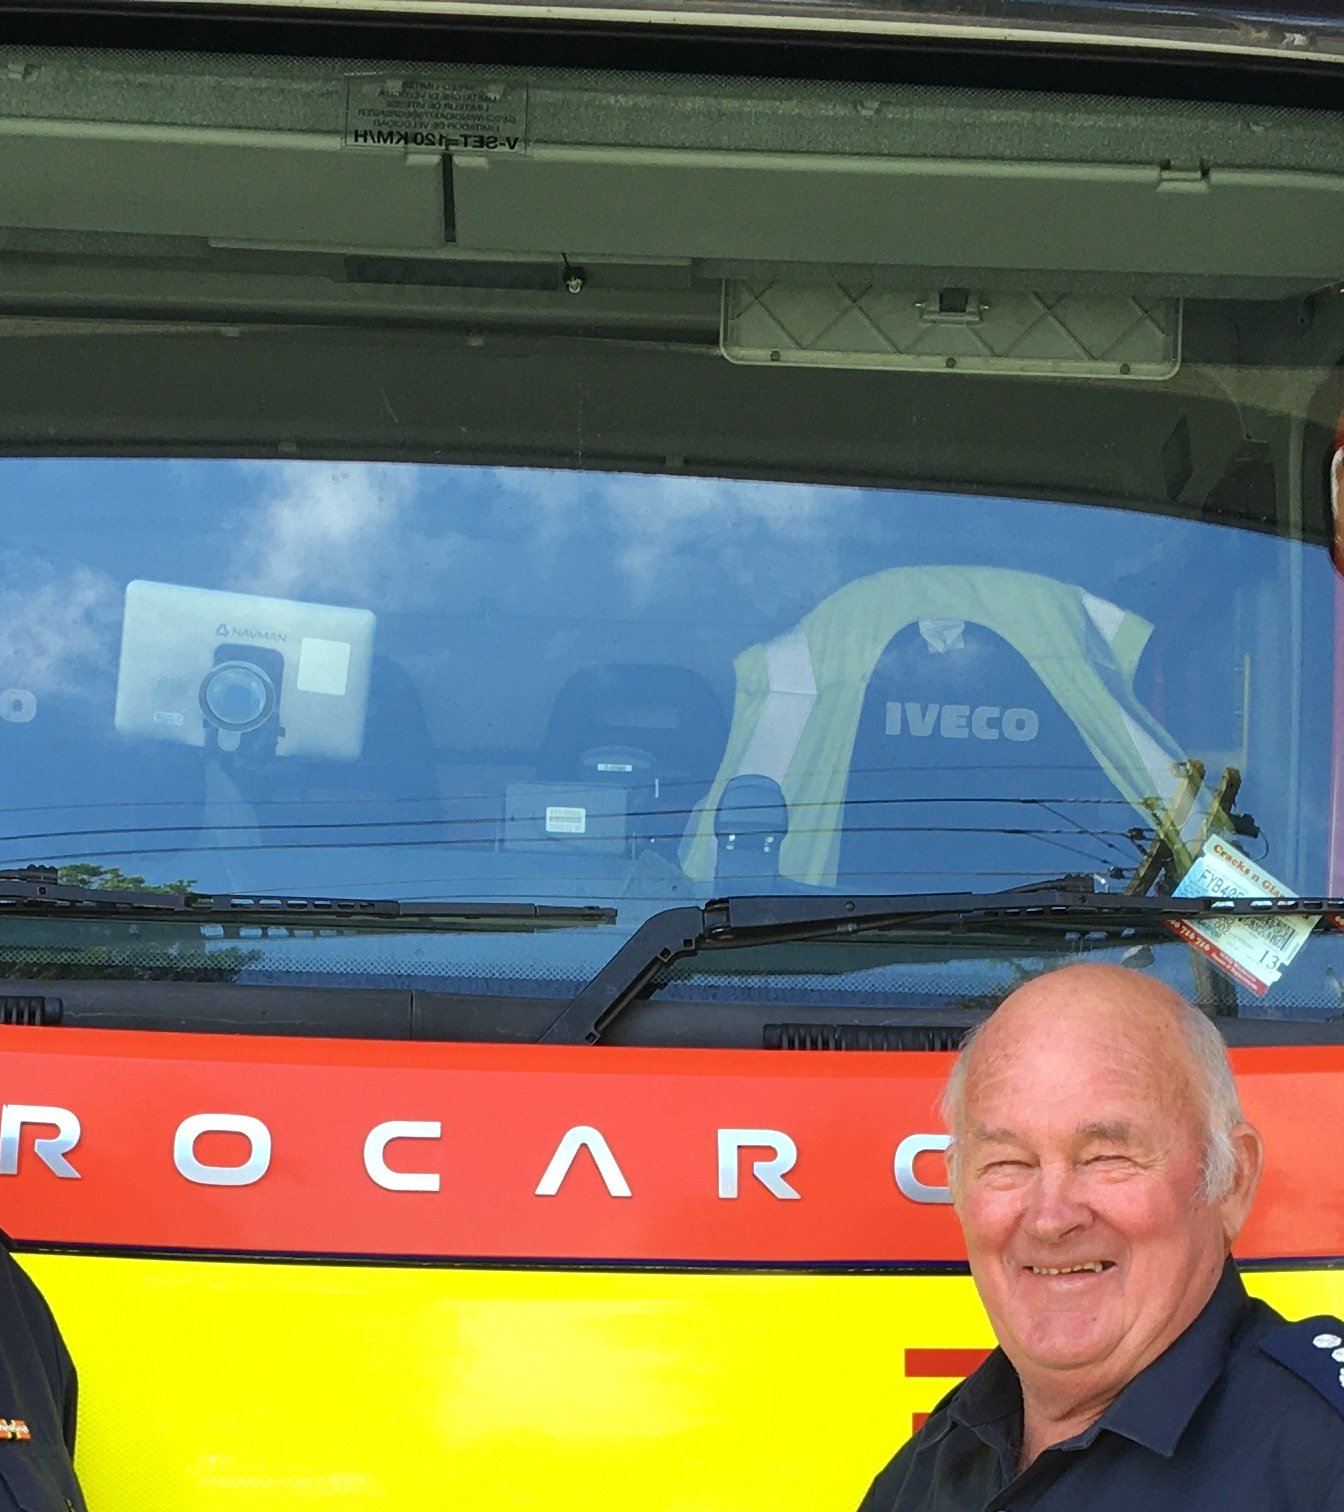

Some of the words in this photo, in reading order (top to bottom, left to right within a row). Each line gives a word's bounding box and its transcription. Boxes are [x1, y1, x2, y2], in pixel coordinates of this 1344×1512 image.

[232, 627, 288, 642] NAVMAN
[885, 701, 1041, 742] IVECO
[1213, 843, 1250, 878] Cracks
[1251, 873, 1260, 882] n
[1258, 949, 1280, 971] 13
